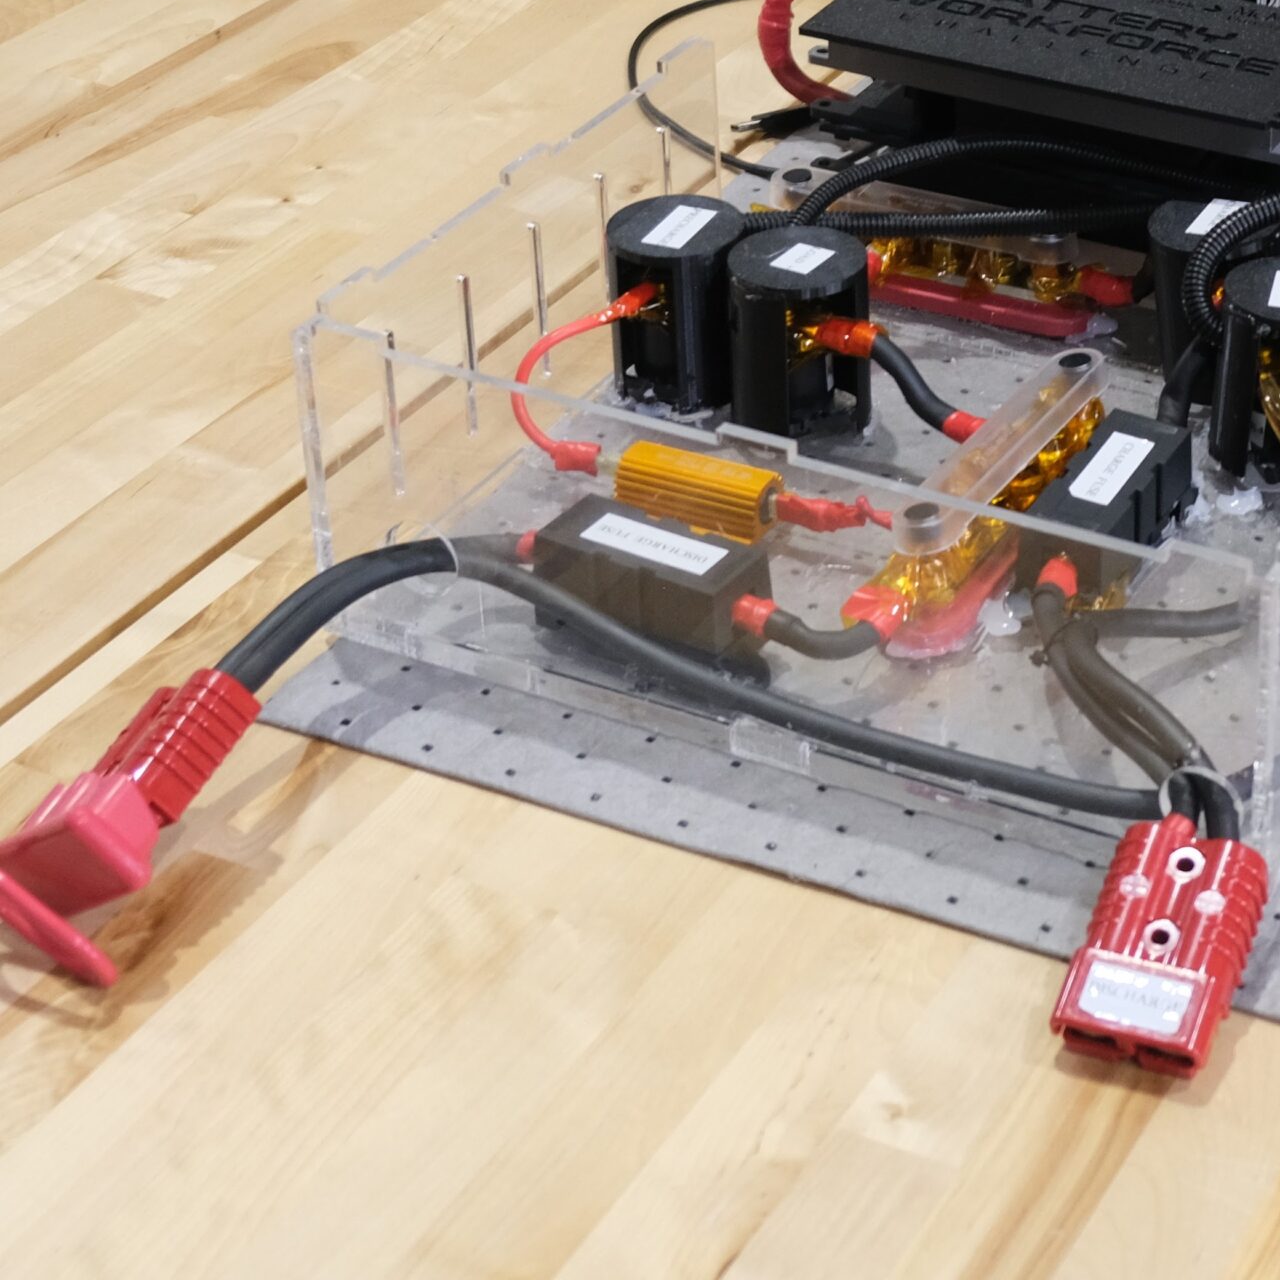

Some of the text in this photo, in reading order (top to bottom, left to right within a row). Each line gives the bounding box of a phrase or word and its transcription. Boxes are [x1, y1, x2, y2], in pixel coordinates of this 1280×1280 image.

[1085, 441, 1135, 497] CHARGE FUSE
[600, 522, 709, 565] DISCHARGE FUSE
